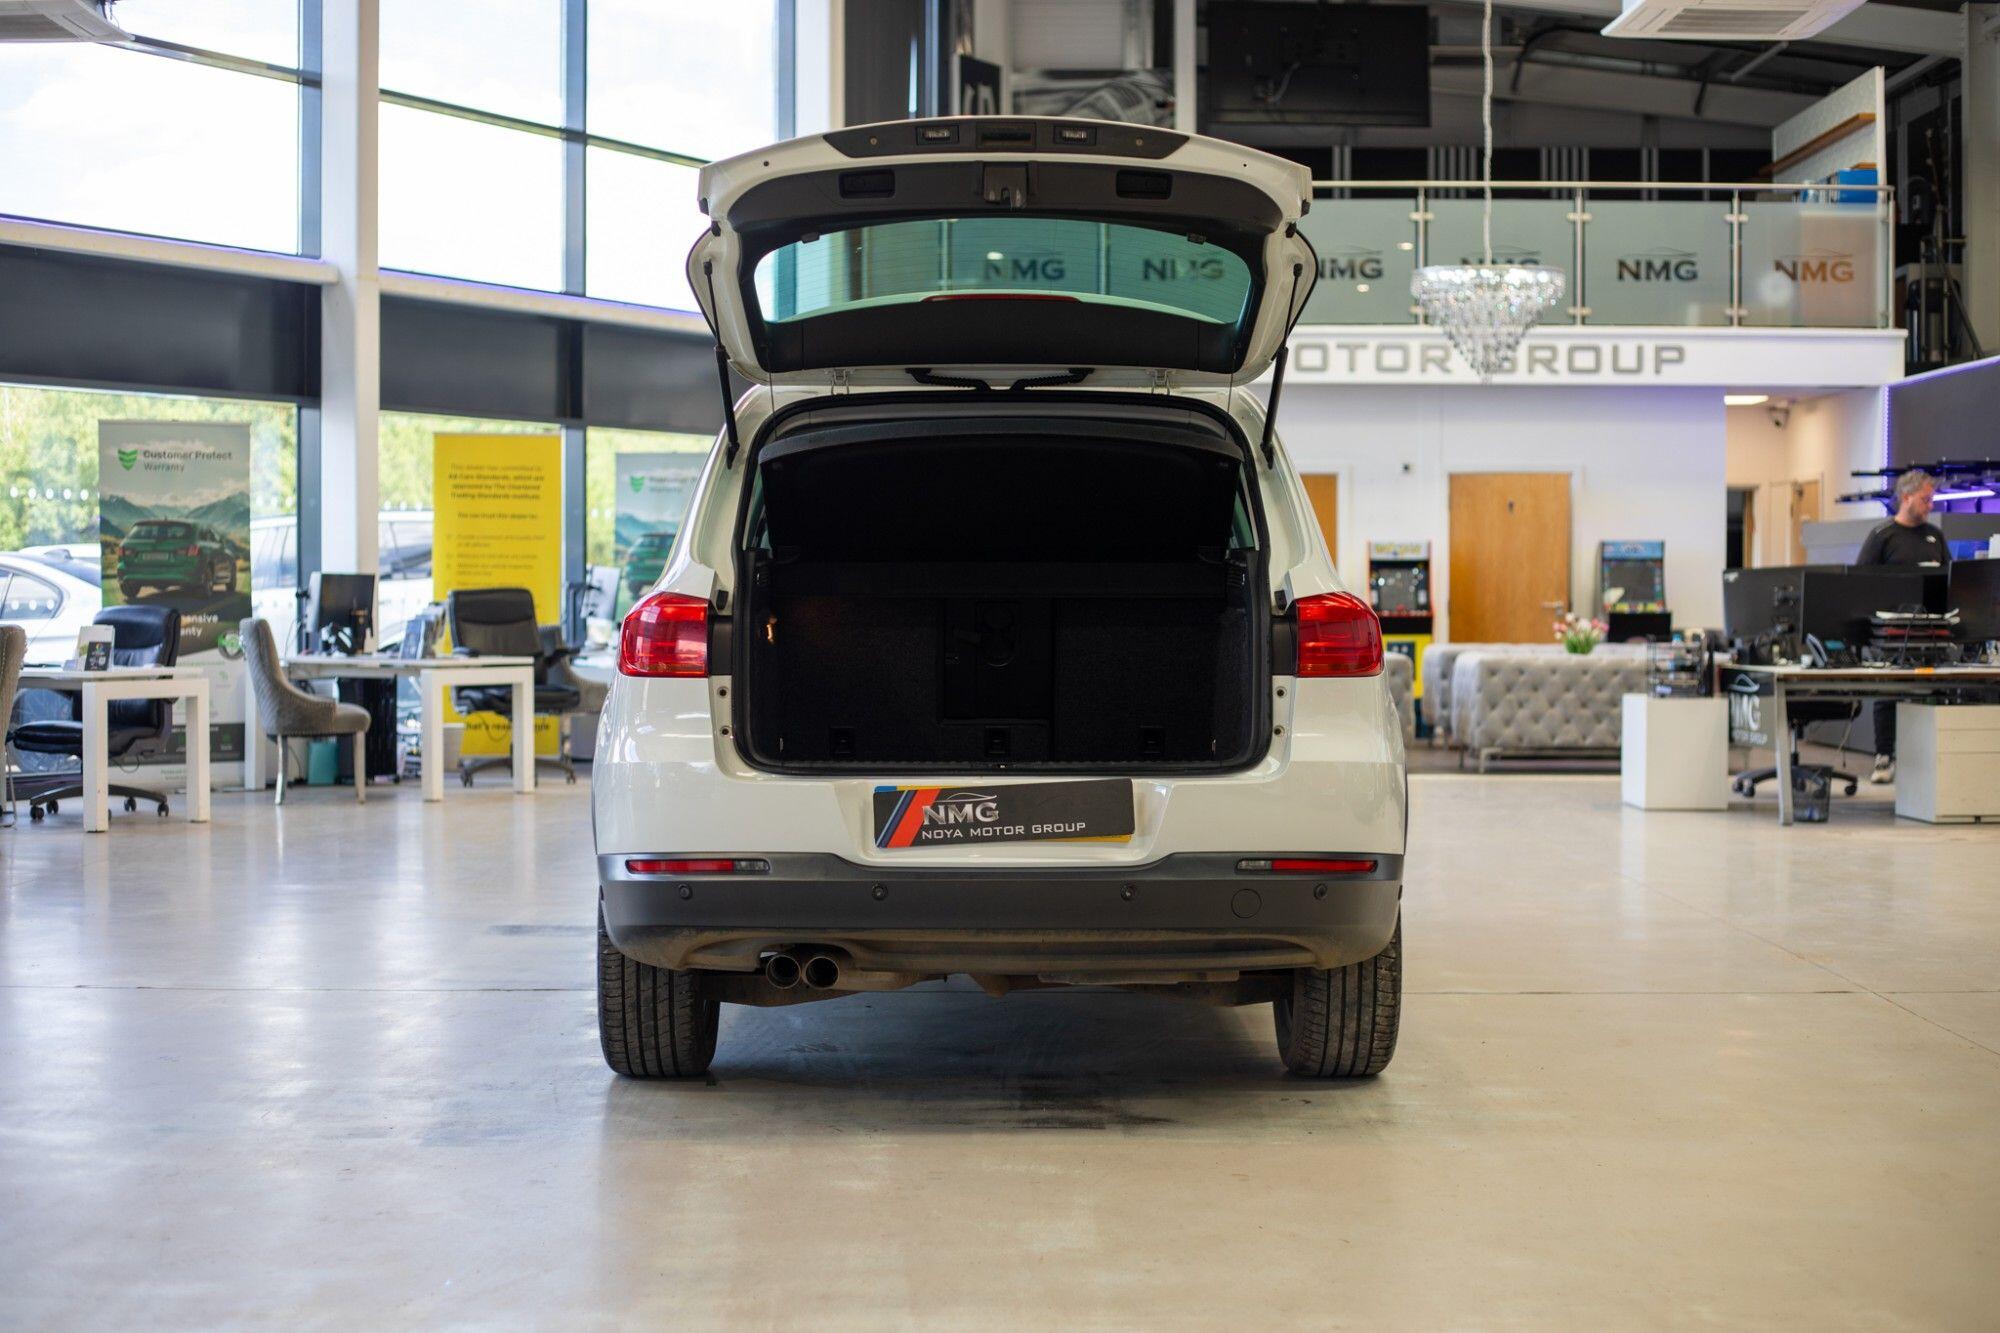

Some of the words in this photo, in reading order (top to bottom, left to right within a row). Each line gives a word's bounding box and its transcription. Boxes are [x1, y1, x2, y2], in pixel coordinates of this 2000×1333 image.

[1617, 259, 1699, 282] NMG
[1293, 342, 1453, 374] OTOR
[143, 449, 195, 460] Customer
[196, 451, 233, 461] Protect
[144, 462, 185, 472] Warranty
[1730, 692, 1761, 731] MG
[922, 801, 1000, 826] NMG
[921, 828, 964, 841] NOYA
[970, 825, 1026, 838] MOTOR
[1031, 822, 1087, 834] GROUP
